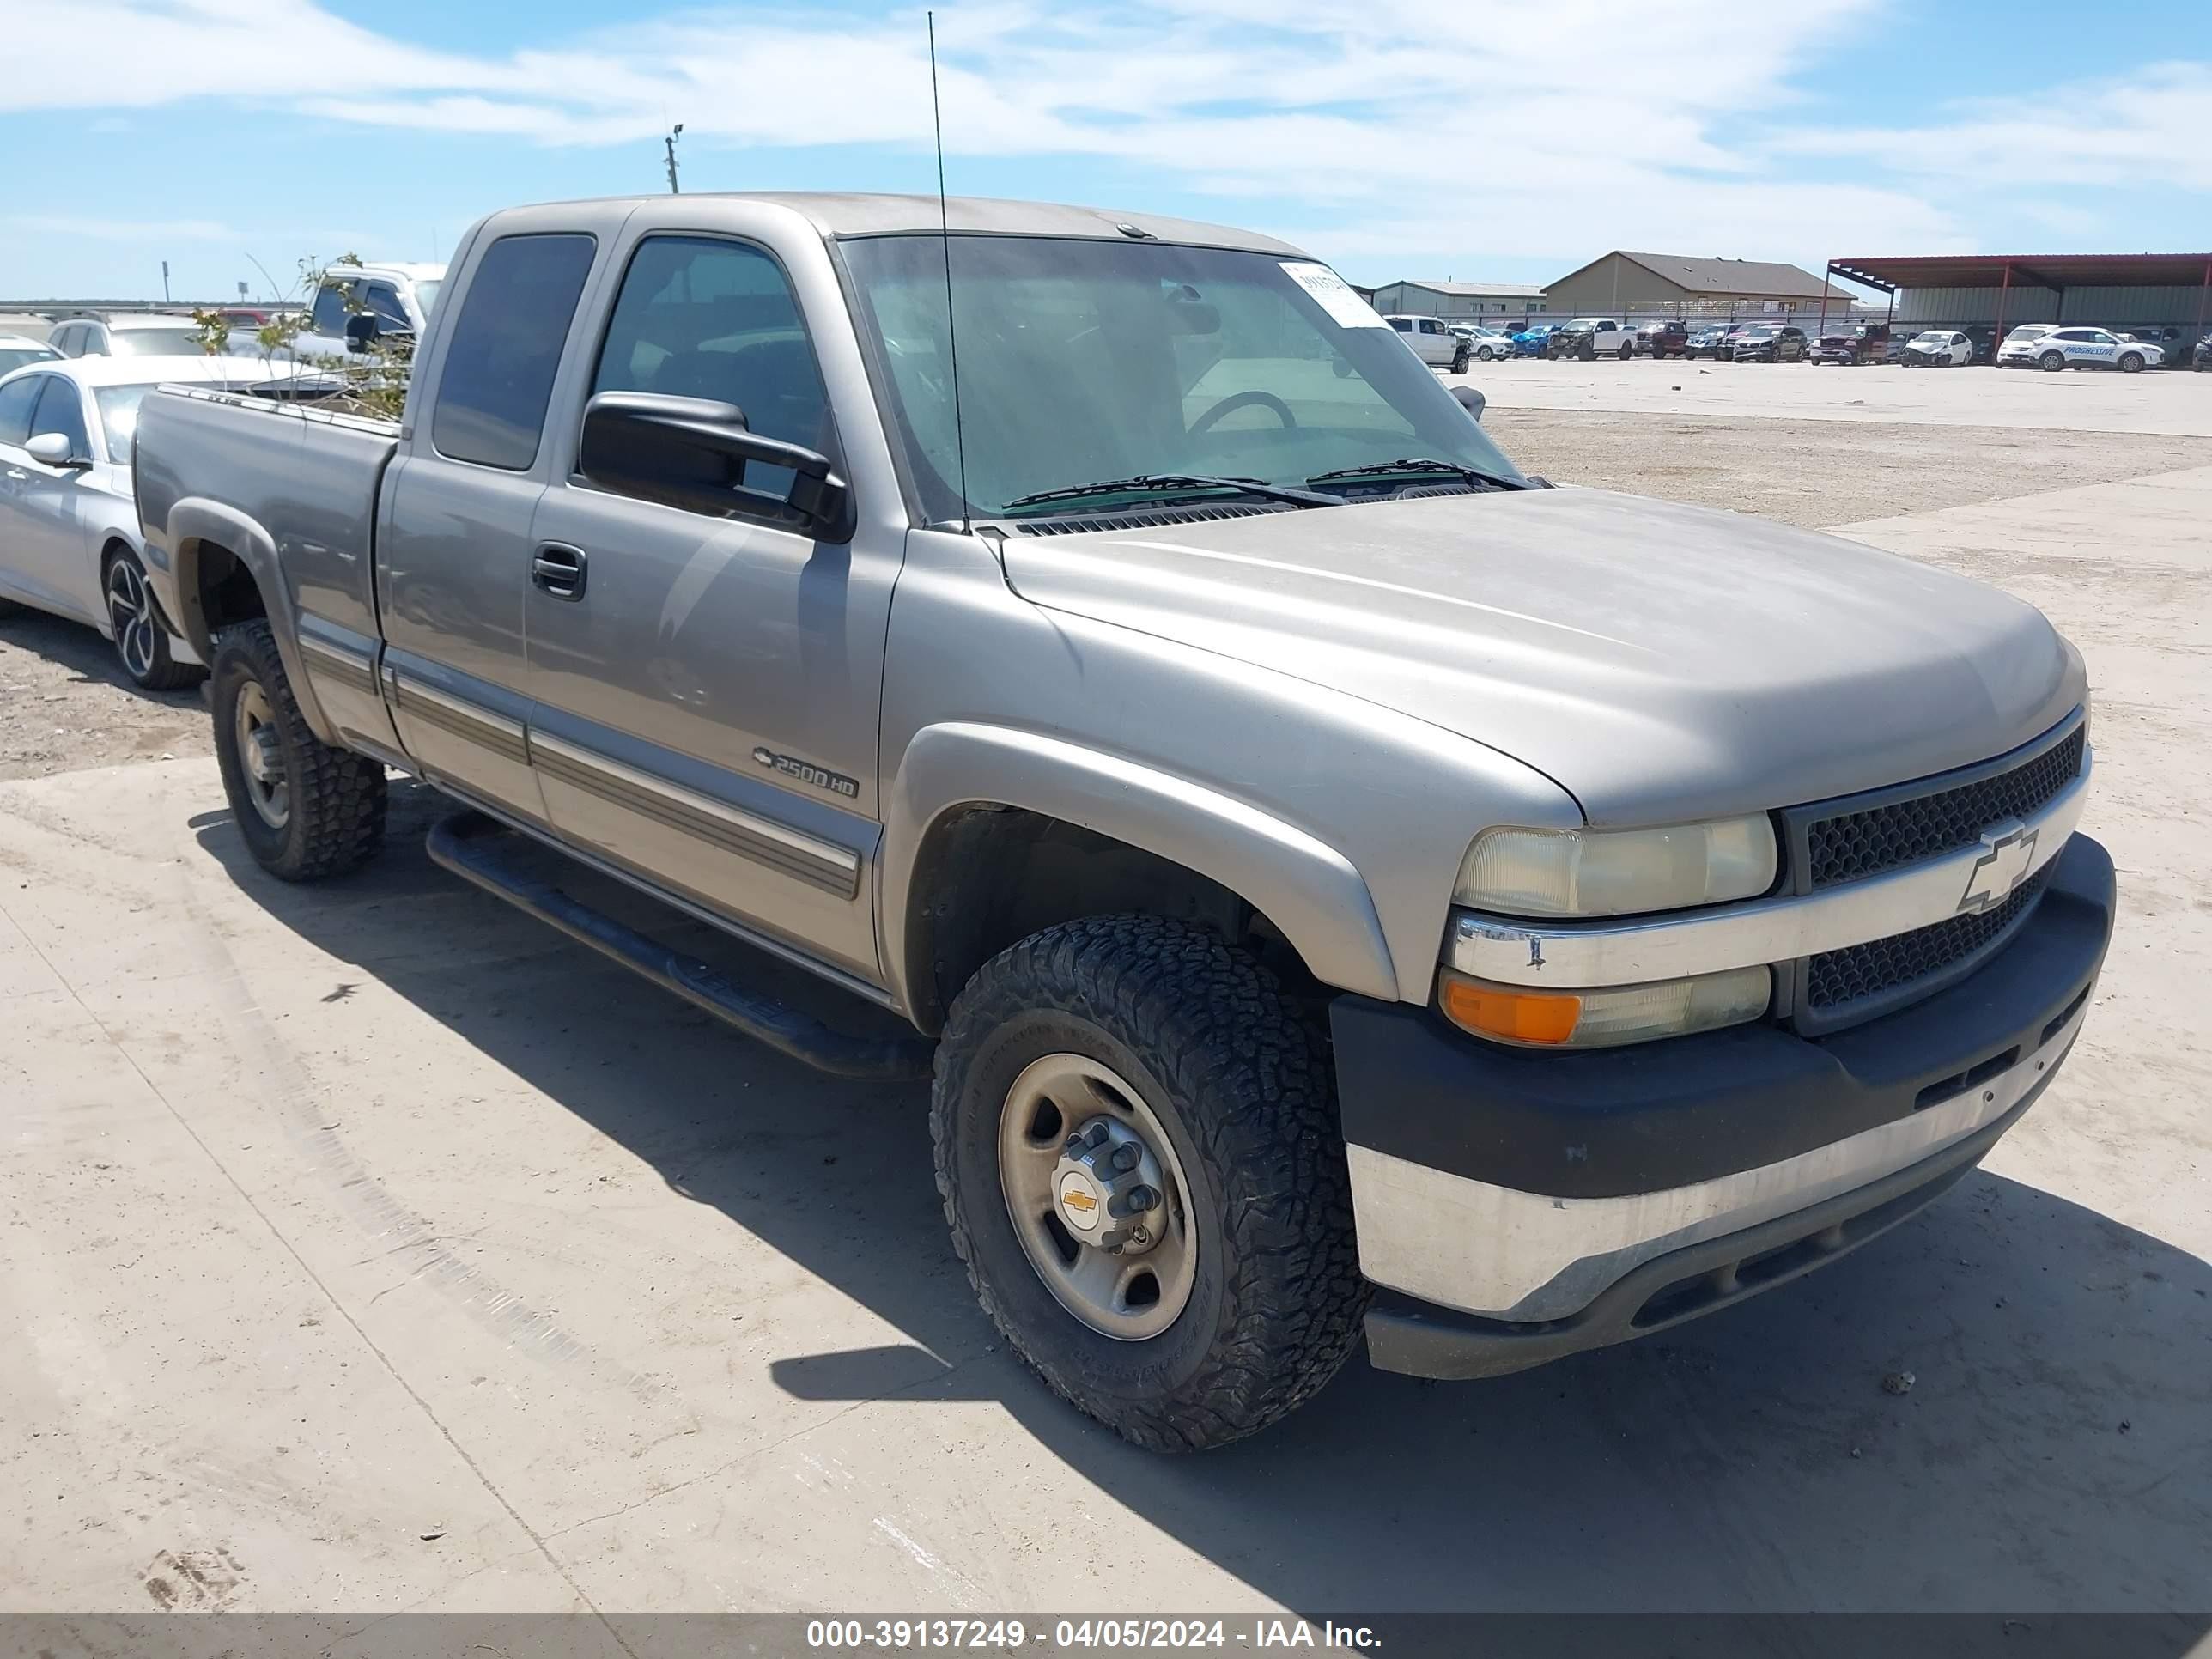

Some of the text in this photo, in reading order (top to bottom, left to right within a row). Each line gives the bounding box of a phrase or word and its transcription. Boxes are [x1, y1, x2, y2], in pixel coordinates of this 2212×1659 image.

[2063, 346, 2116, 356] PROGRESSIVE
[775, 757, 855, 796] 2500 HD
